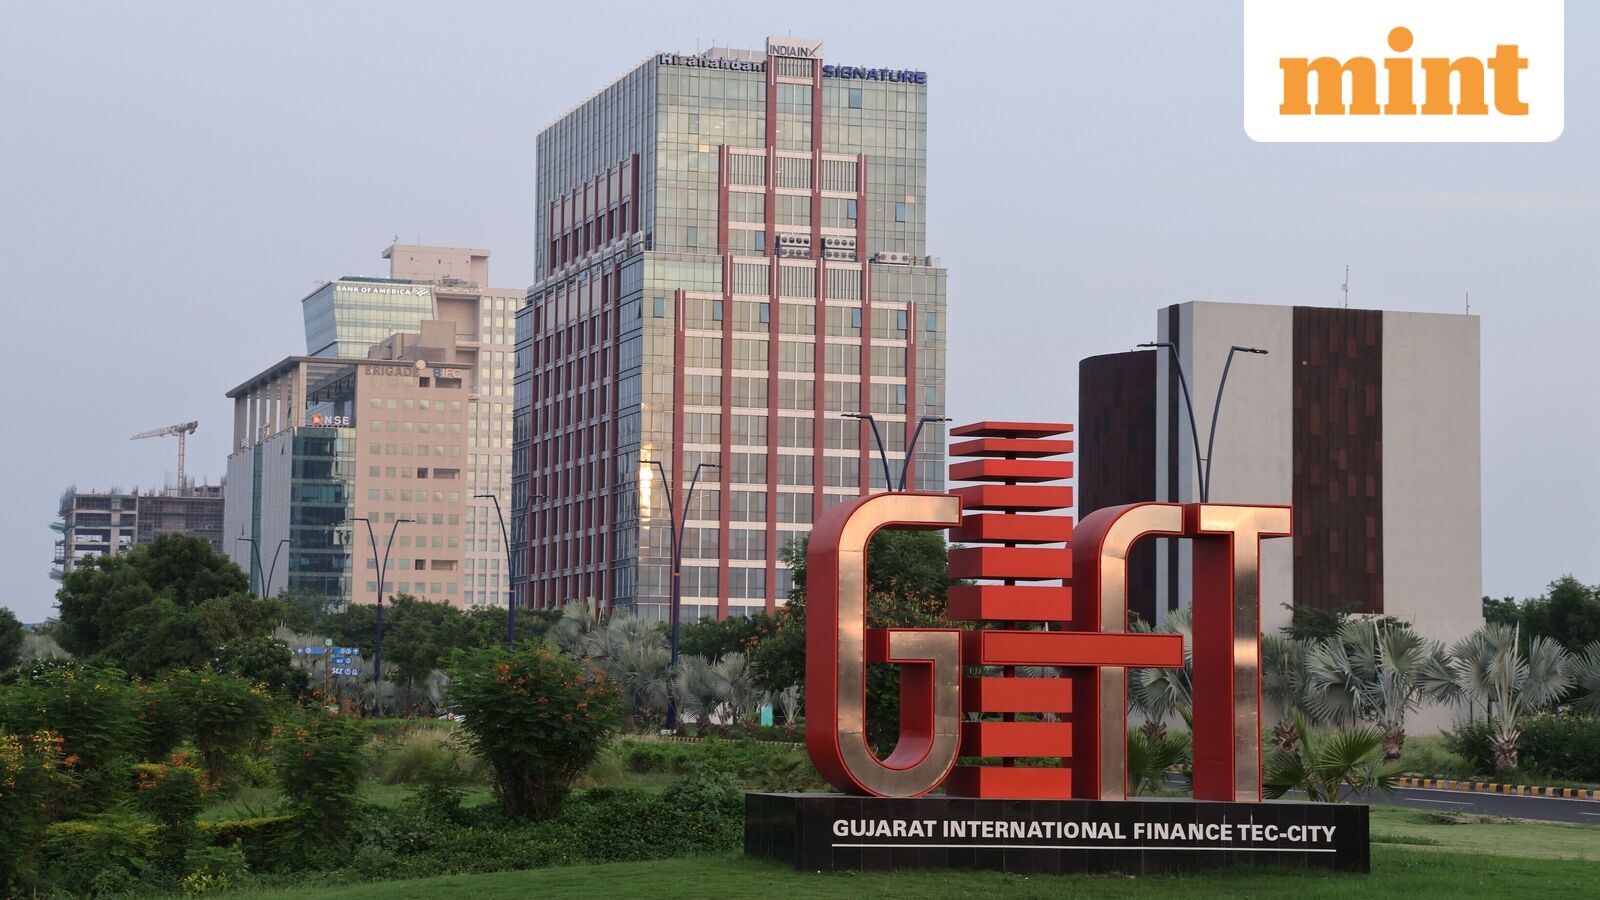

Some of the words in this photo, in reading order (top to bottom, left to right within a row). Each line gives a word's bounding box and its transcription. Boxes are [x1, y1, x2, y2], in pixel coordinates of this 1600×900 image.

[822, 64, 927, 84] SIGNATURE
[336, 285, 359, 293] BANK
[373, 287, 411, 295] AMERICA
[365, 366, 420, 377] BRIGADE
[324, 415, 350, 425] NSE
[806, 421, 1293, 802] GIFT
[832, 819, 938, 838] GUJARAT
[942, 820, 1127, 840] INTERNATIONAL
[1133, 821, 1233, 841] FINANCE
[1237, 823, 1337, 843] TEC-CITY
